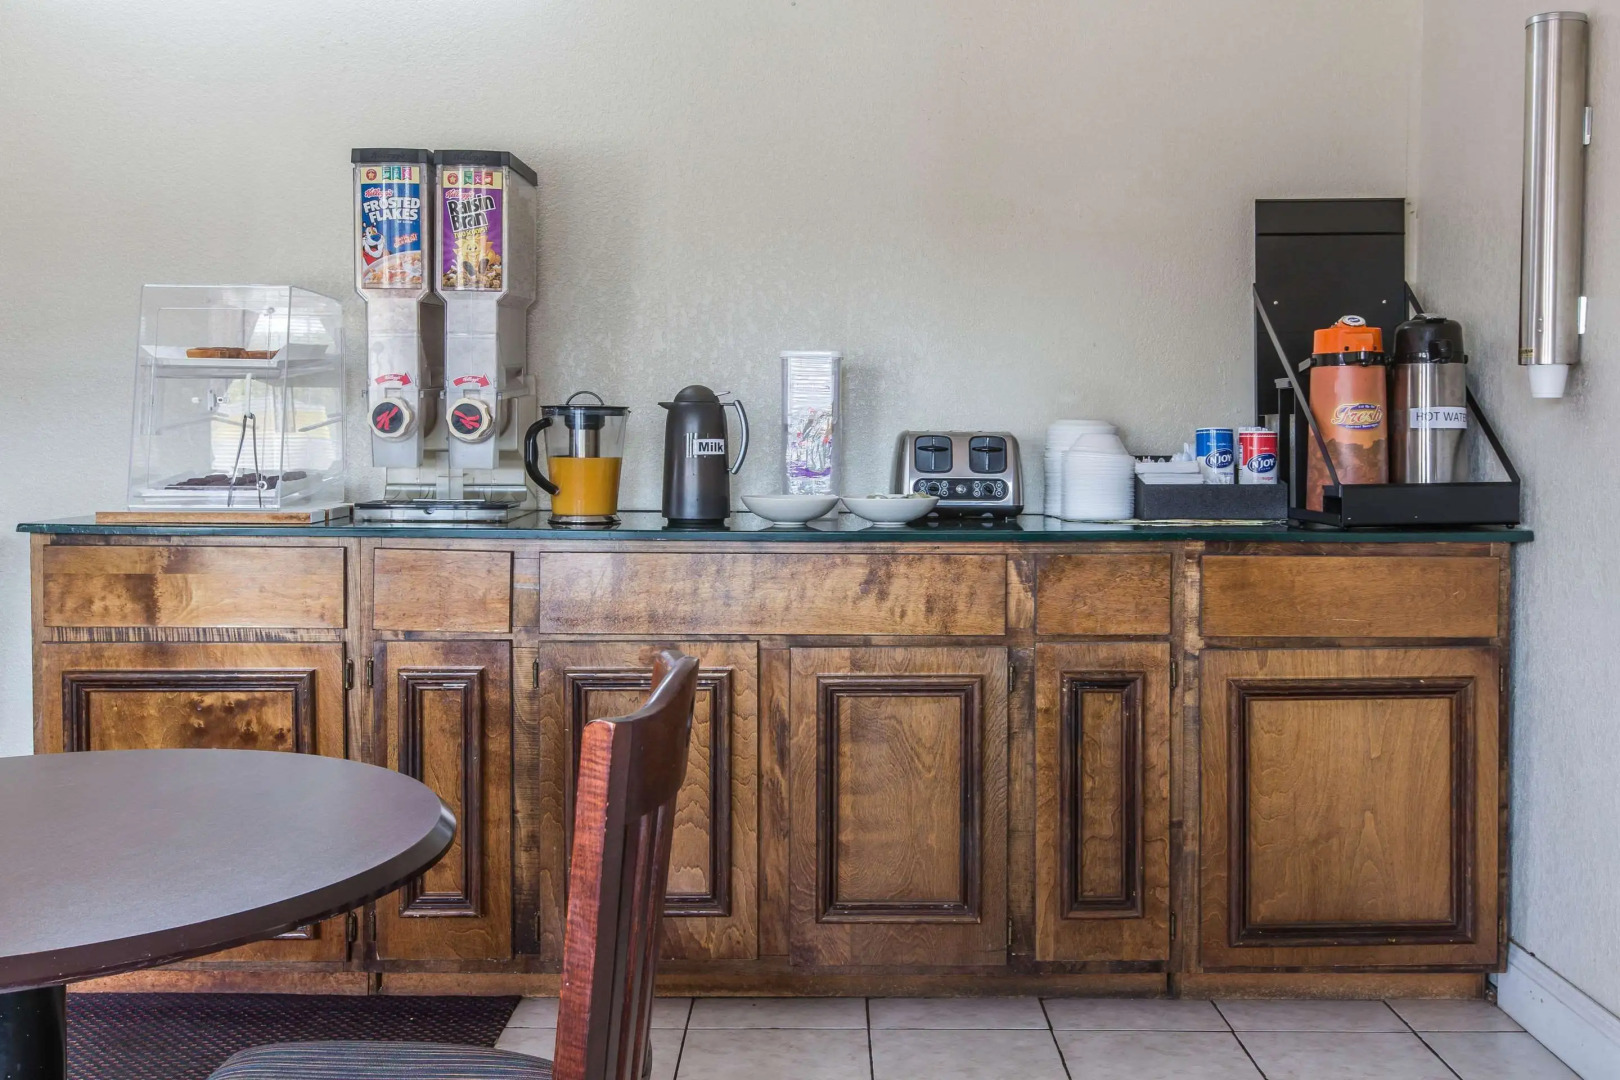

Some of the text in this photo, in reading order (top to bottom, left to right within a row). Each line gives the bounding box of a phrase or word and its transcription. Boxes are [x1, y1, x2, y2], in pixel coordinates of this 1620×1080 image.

[363, 197, 420, 213] FROSTED
[447, 194, 496, 215] Raisin
[368, 208, 419, 223] FLAKES
[450, 212, 488, 232] Bran
[376, 405, 399, 430] K
[1331, 403, 1383, 424] Fresh
[1416, 411, 1467, 422] HOT WATE
[698, 442, 724, 453] Milk
[1252, 458, 1275, 468] N'JOY
